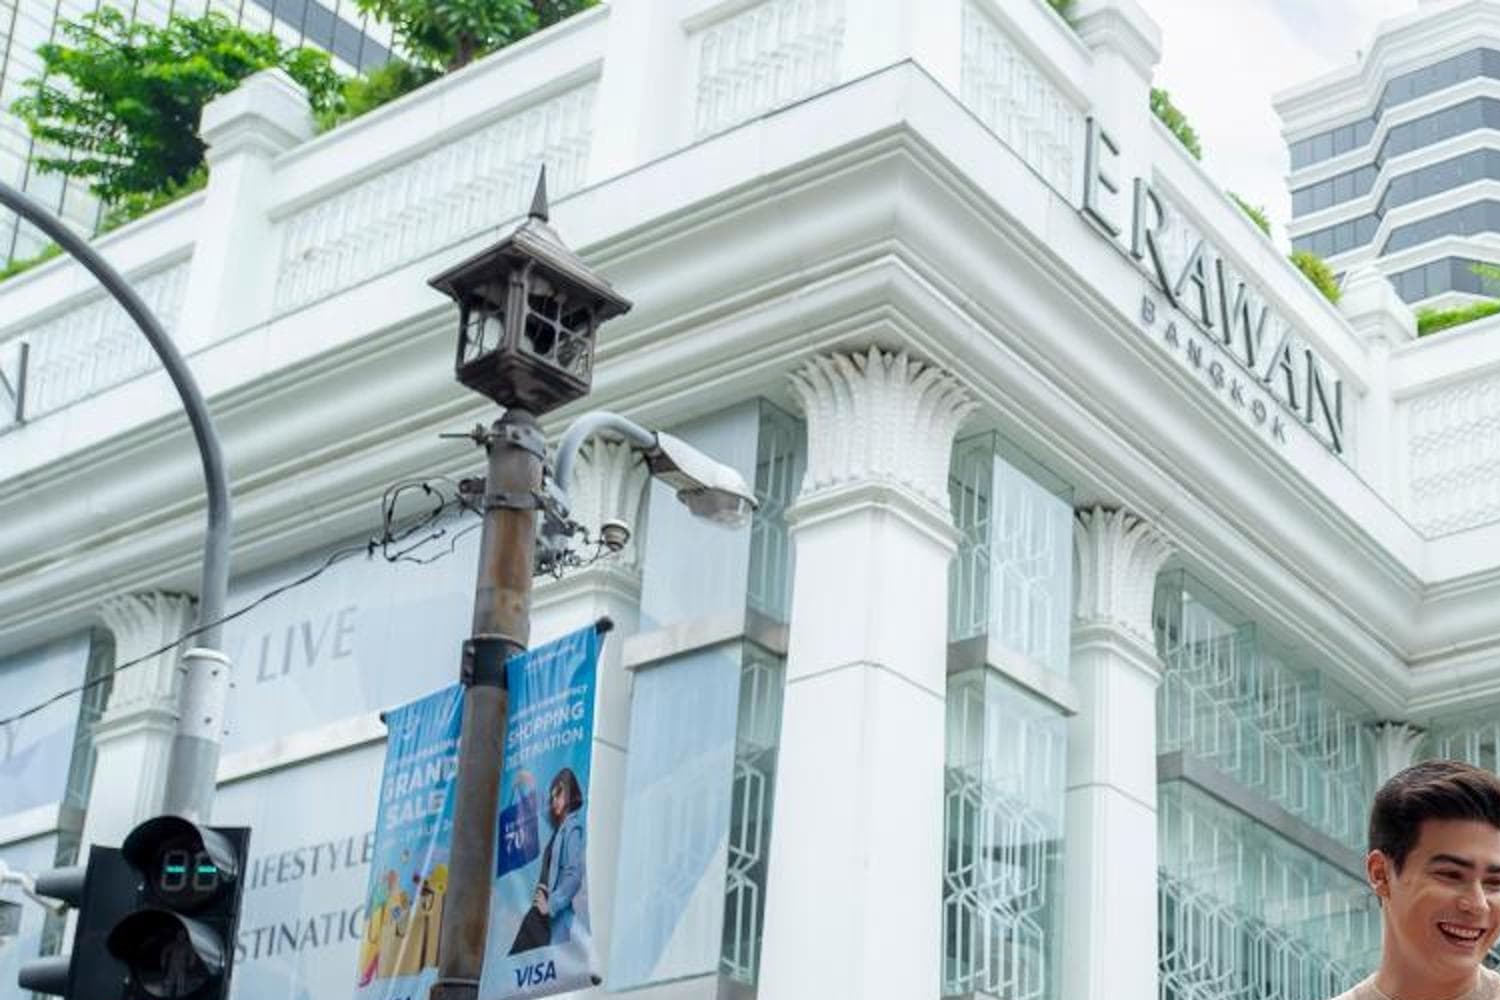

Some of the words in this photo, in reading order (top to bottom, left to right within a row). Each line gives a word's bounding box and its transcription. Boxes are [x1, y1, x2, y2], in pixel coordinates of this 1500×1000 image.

[1079, 116, 1344, 453] ERAWAN
[1141, 295, 1287, 444] BANGKOK
[256, 605, 358, 683] LIVE
[251, 831, 374, 890] IFESTYLE
[514, 960, 558, 988] VISA
